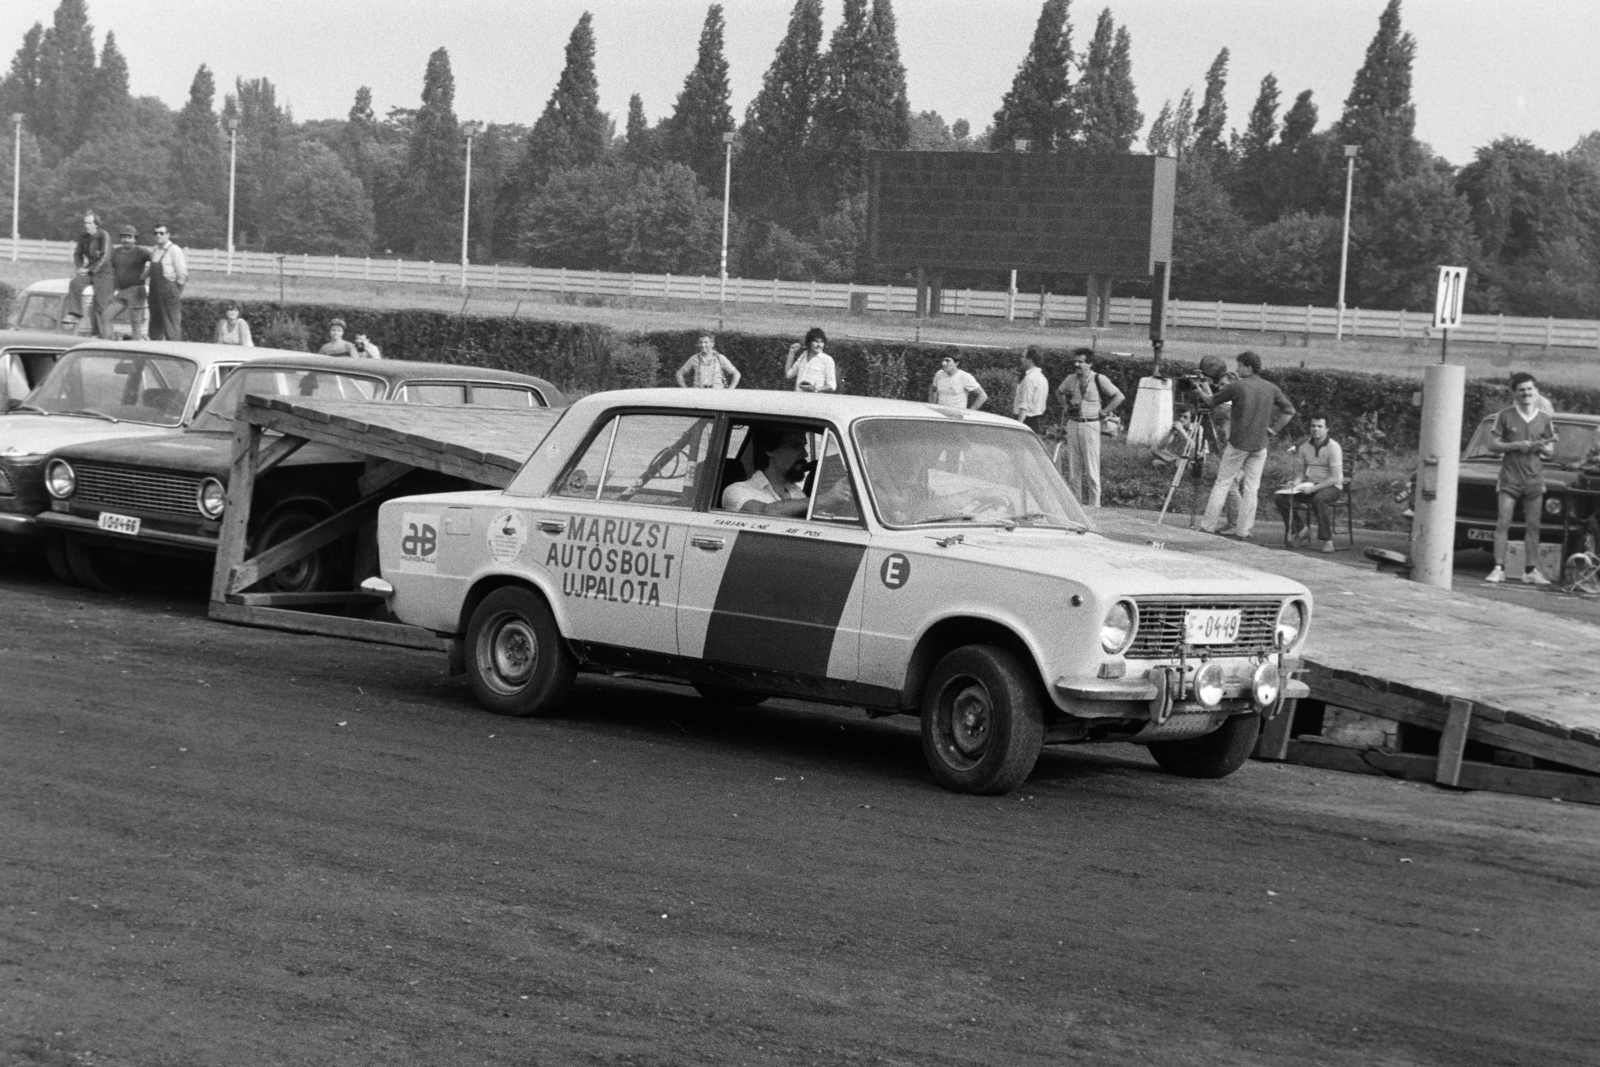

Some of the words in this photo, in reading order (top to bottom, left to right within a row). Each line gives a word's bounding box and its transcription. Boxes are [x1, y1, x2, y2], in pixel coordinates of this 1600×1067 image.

[1440, 270, 1461, 325] 20
[567, 516, 670, 550] MARUZSI
[545, 543, 675, 579] AUTÓSBOLT
[886, 558, 903, 584] E
[563, 573, 660, 607] UJPALOTA
